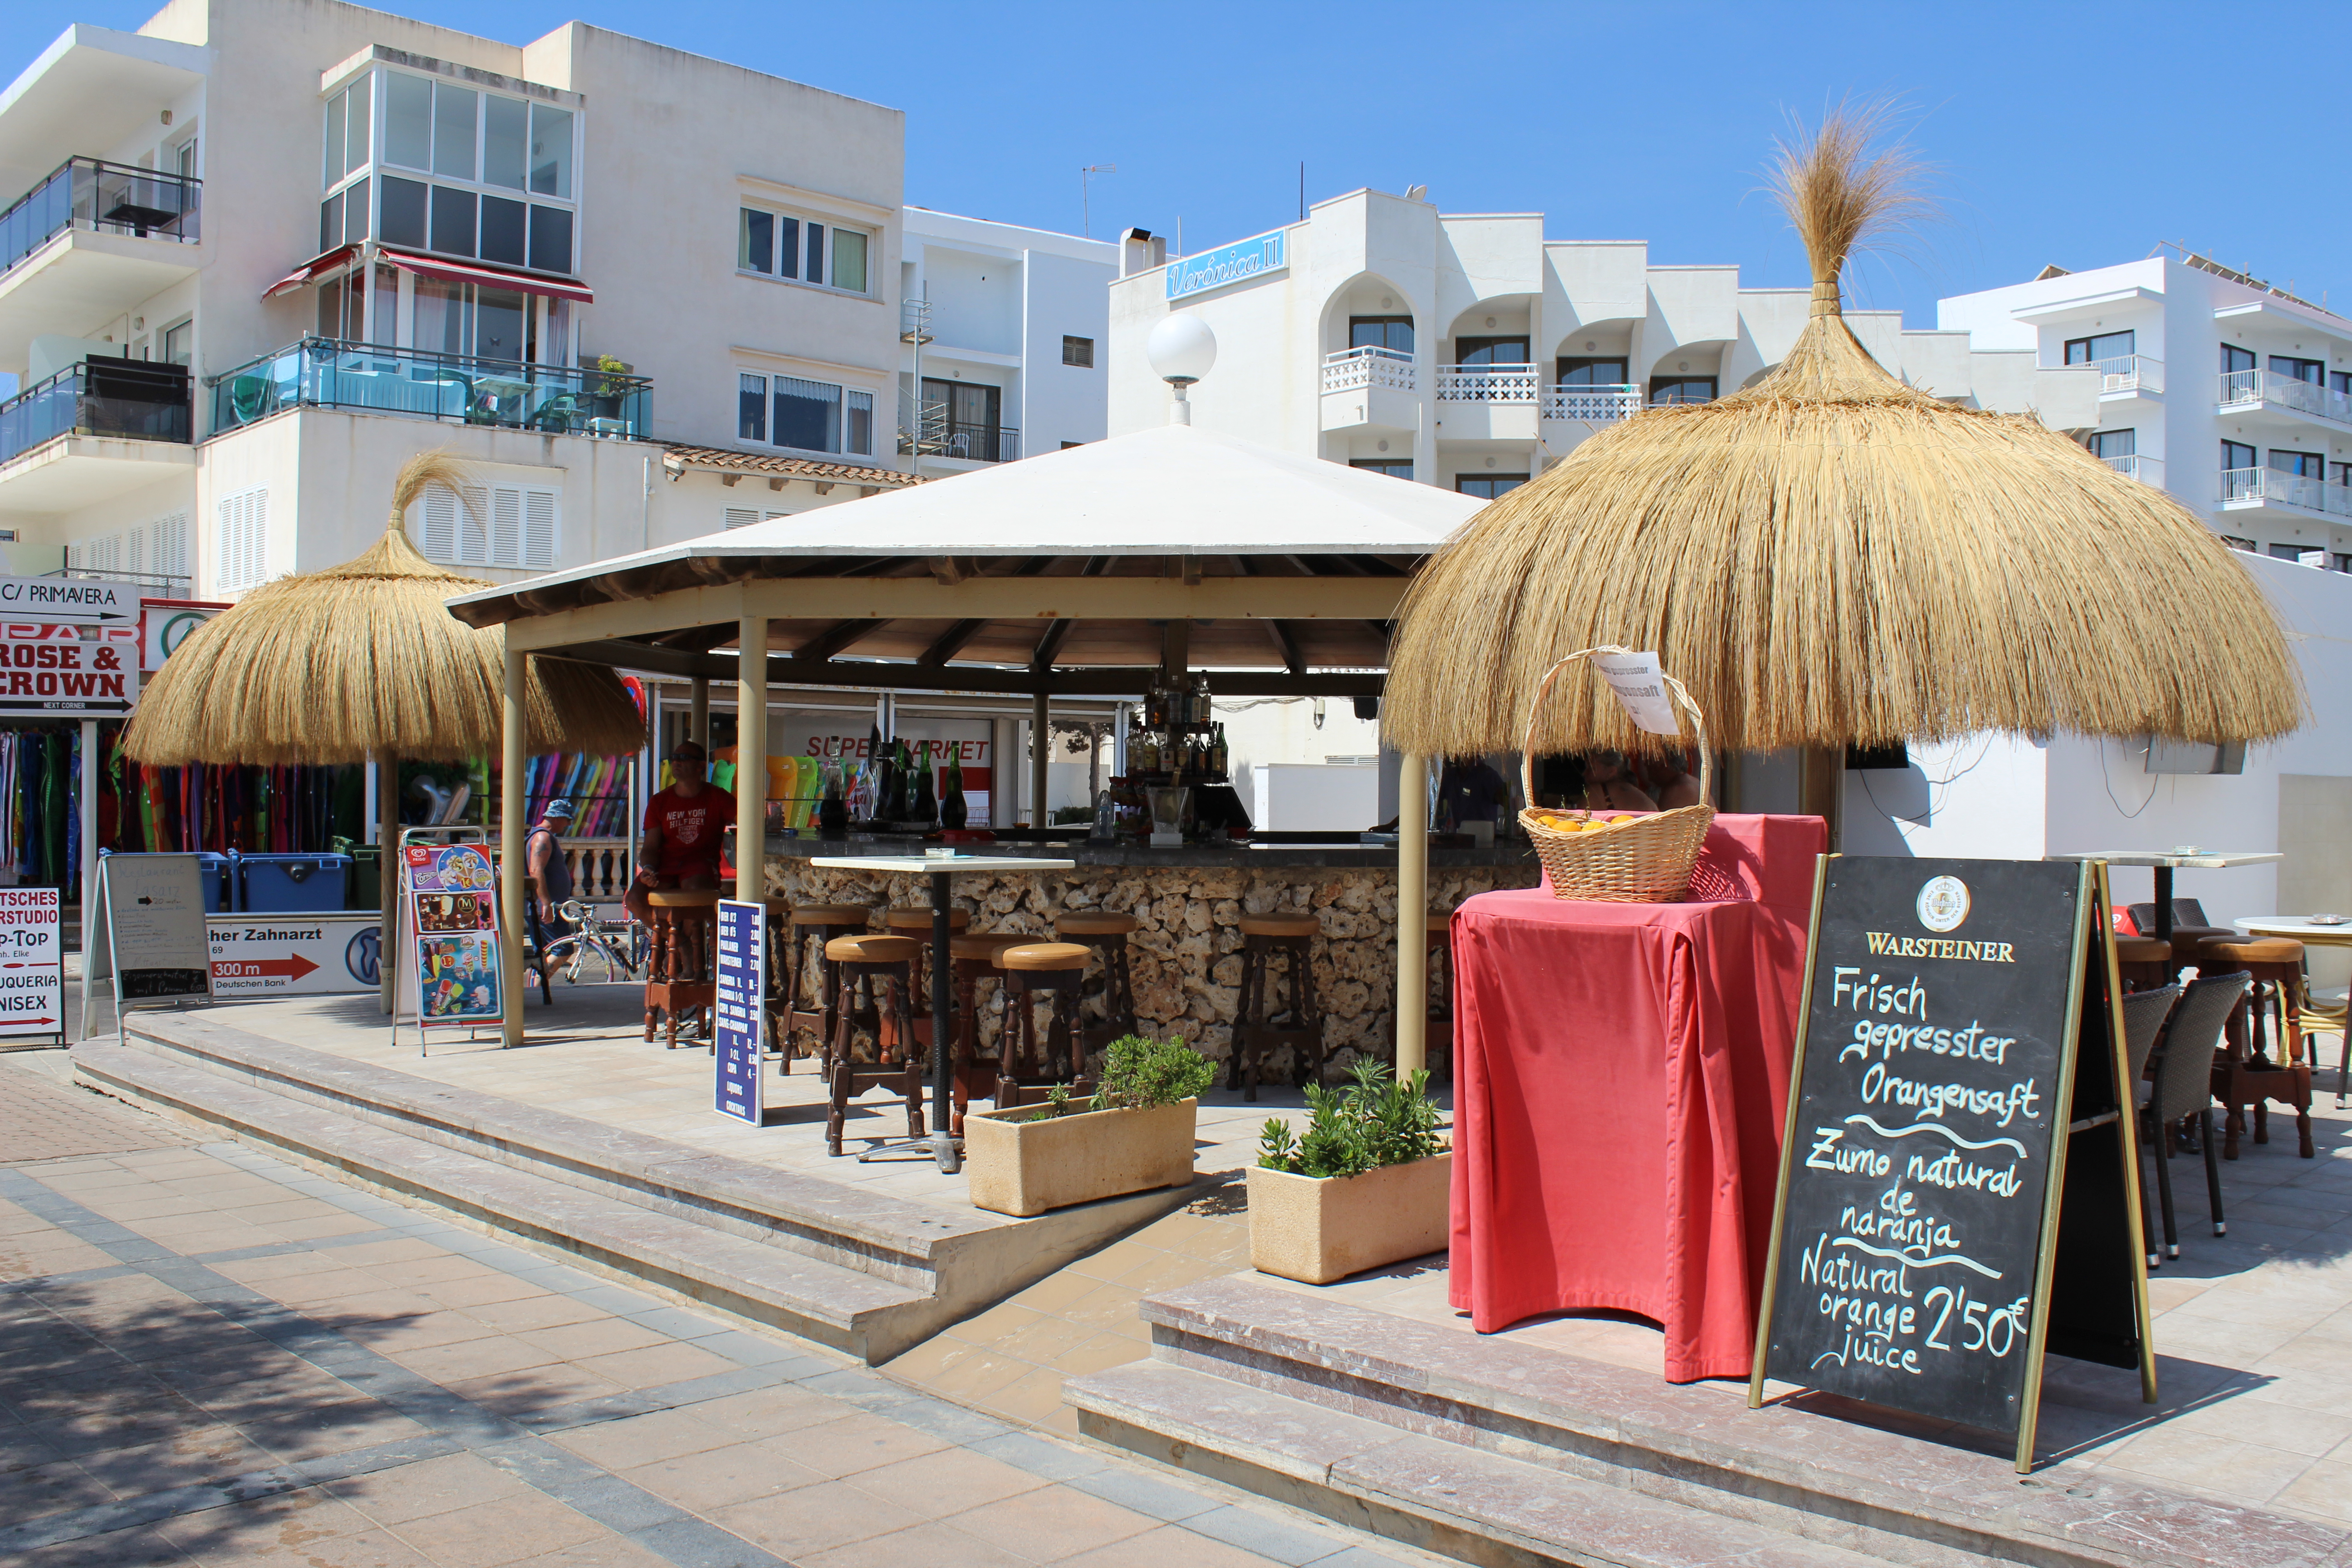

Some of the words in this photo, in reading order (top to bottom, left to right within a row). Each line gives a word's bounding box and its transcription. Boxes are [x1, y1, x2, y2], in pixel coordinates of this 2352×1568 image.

[1170, 250, 1259, 295] Verónica
[1263, 237, 1279, 269] II
[2, 584, 23, 600] C/
[30, 585, 117, 605] PRIMAVERA
[93, 647, 121, 670] &
[666, 811, 685, 821] NEW
[720, 911, 729, 922] BIER
[1950, 910, 1959, 919] DEN
[207, 929, 240, 941] her
[244, 928, 322, 941] Zahnarzt
[720, 926, 729, 936] BIER
[720, 940, 739, 952] PAULANER
[1866, 931, 2015, 962] WARSTEINER
[215, 963, 241, 975] 300
[245, 965, 260, 975] m
[720, 954, 742, 968] WARSTEINER
[216, 980, 262, 989] Deutschen
[720, 974, 735, 987] SANGRIA
[720, 988, 735, 1001] SANGRIA
[1833, 966, 1926, 1021] Frisch
[719, 1002, 728, 1014] COPA
[730, 1004, 746, 1019] SANGRIA
[1838, 1019, 2017, 1065] gepresster
[727, 1062, 737, 1074] COPA
[727, 1081, 743, 1096] LIQUORS
[1861, 1061, 2040, 1128] Orangensaft
[726, 1100, 745, 1117] COCKTAILS
[1805, 1127, 1891, 1177] Zumo
[1907, 1149, 2022, 1197] natural
[1881, 1174, 1916, 1216] de
[1841, 1206, 1960, 1258] naranja
[1800, 1232, 1912, 1298] Natural
[1820, 1292, 1915, 1343] orange
[1810, 1323, 1921, 1374] juice
